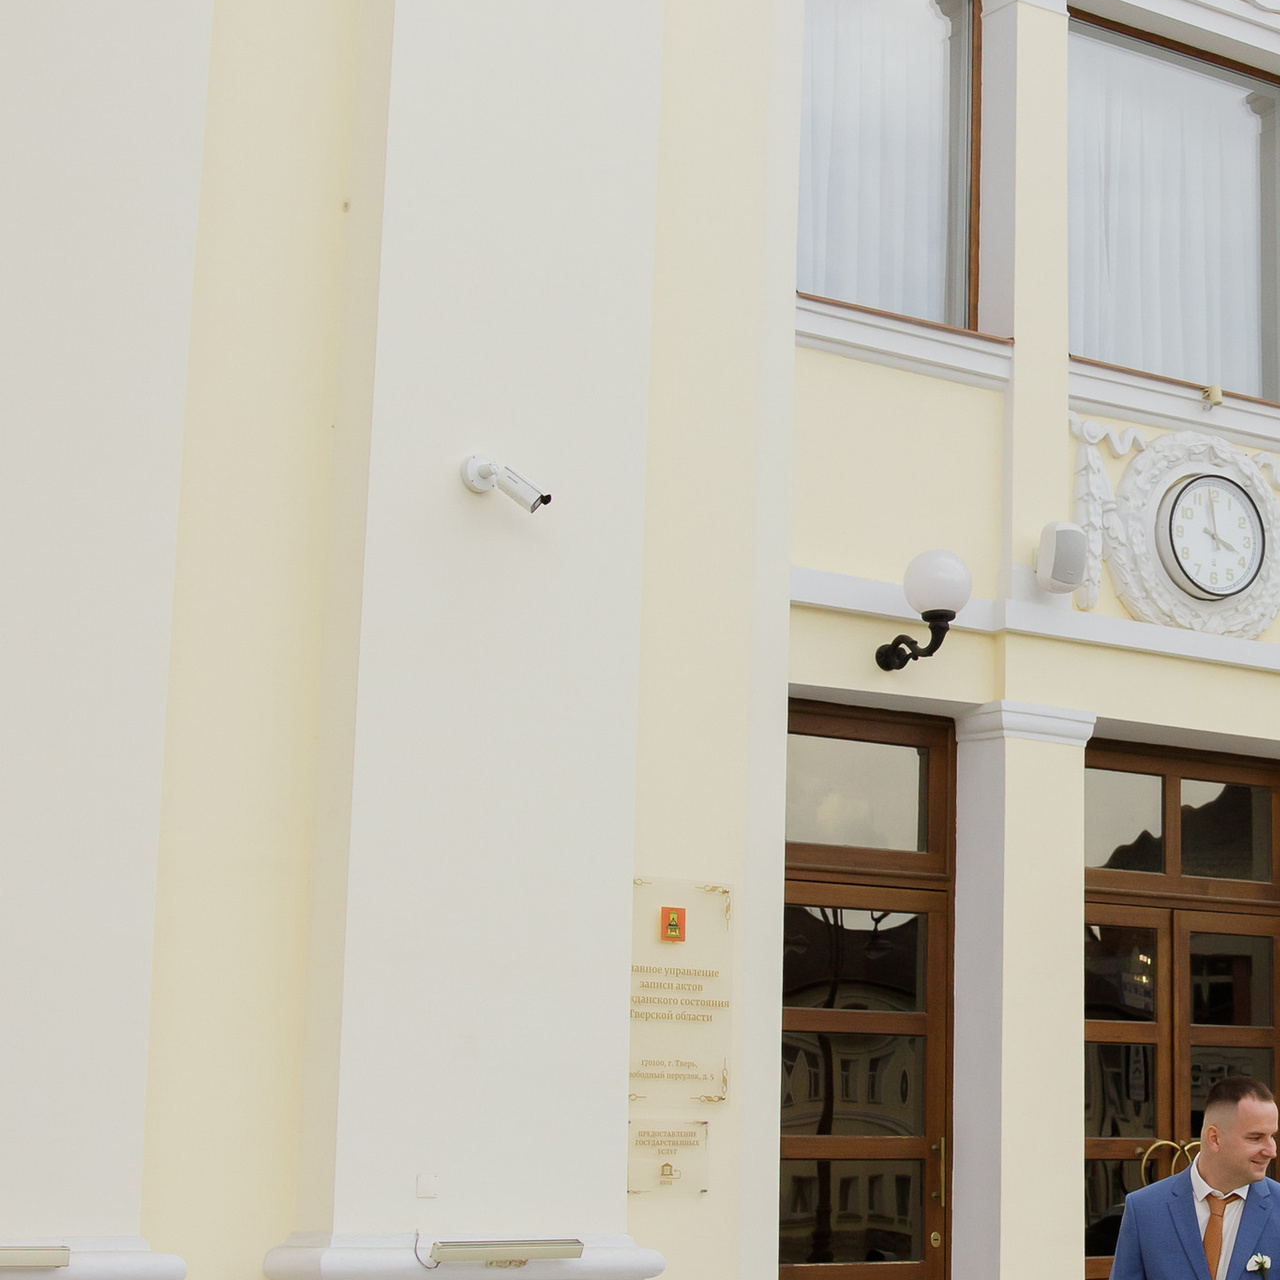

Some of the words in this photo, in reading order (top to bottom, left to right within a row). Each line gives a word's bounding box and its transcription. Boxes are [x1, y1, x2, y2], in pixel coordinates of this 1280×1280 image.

[1193, 492, 1202, 506] 11
[1227, 498, 1232, 511] 1
[1181, 506, 1194, 520] 10
[1238, 516, 1247, 529] 2
[1175, 524, 1185, 538] 9
[1243, 536, 1251, 549] 3
[1181, 546, 1190, 560] 8
[1237, 556, 1246, 569] 4
[1193, 563, 1202, 576] 7
[1225, 568, 1234, 581] 5
[1209, 572, 1218, 584] 6
[664, 967, 720, 977] управление
[639, 980, 673, 990] записи
[675, 983, 704, 991] актов
[680, 998, 730, 1008] состояния
[675, 1010, 713, 1022] области
